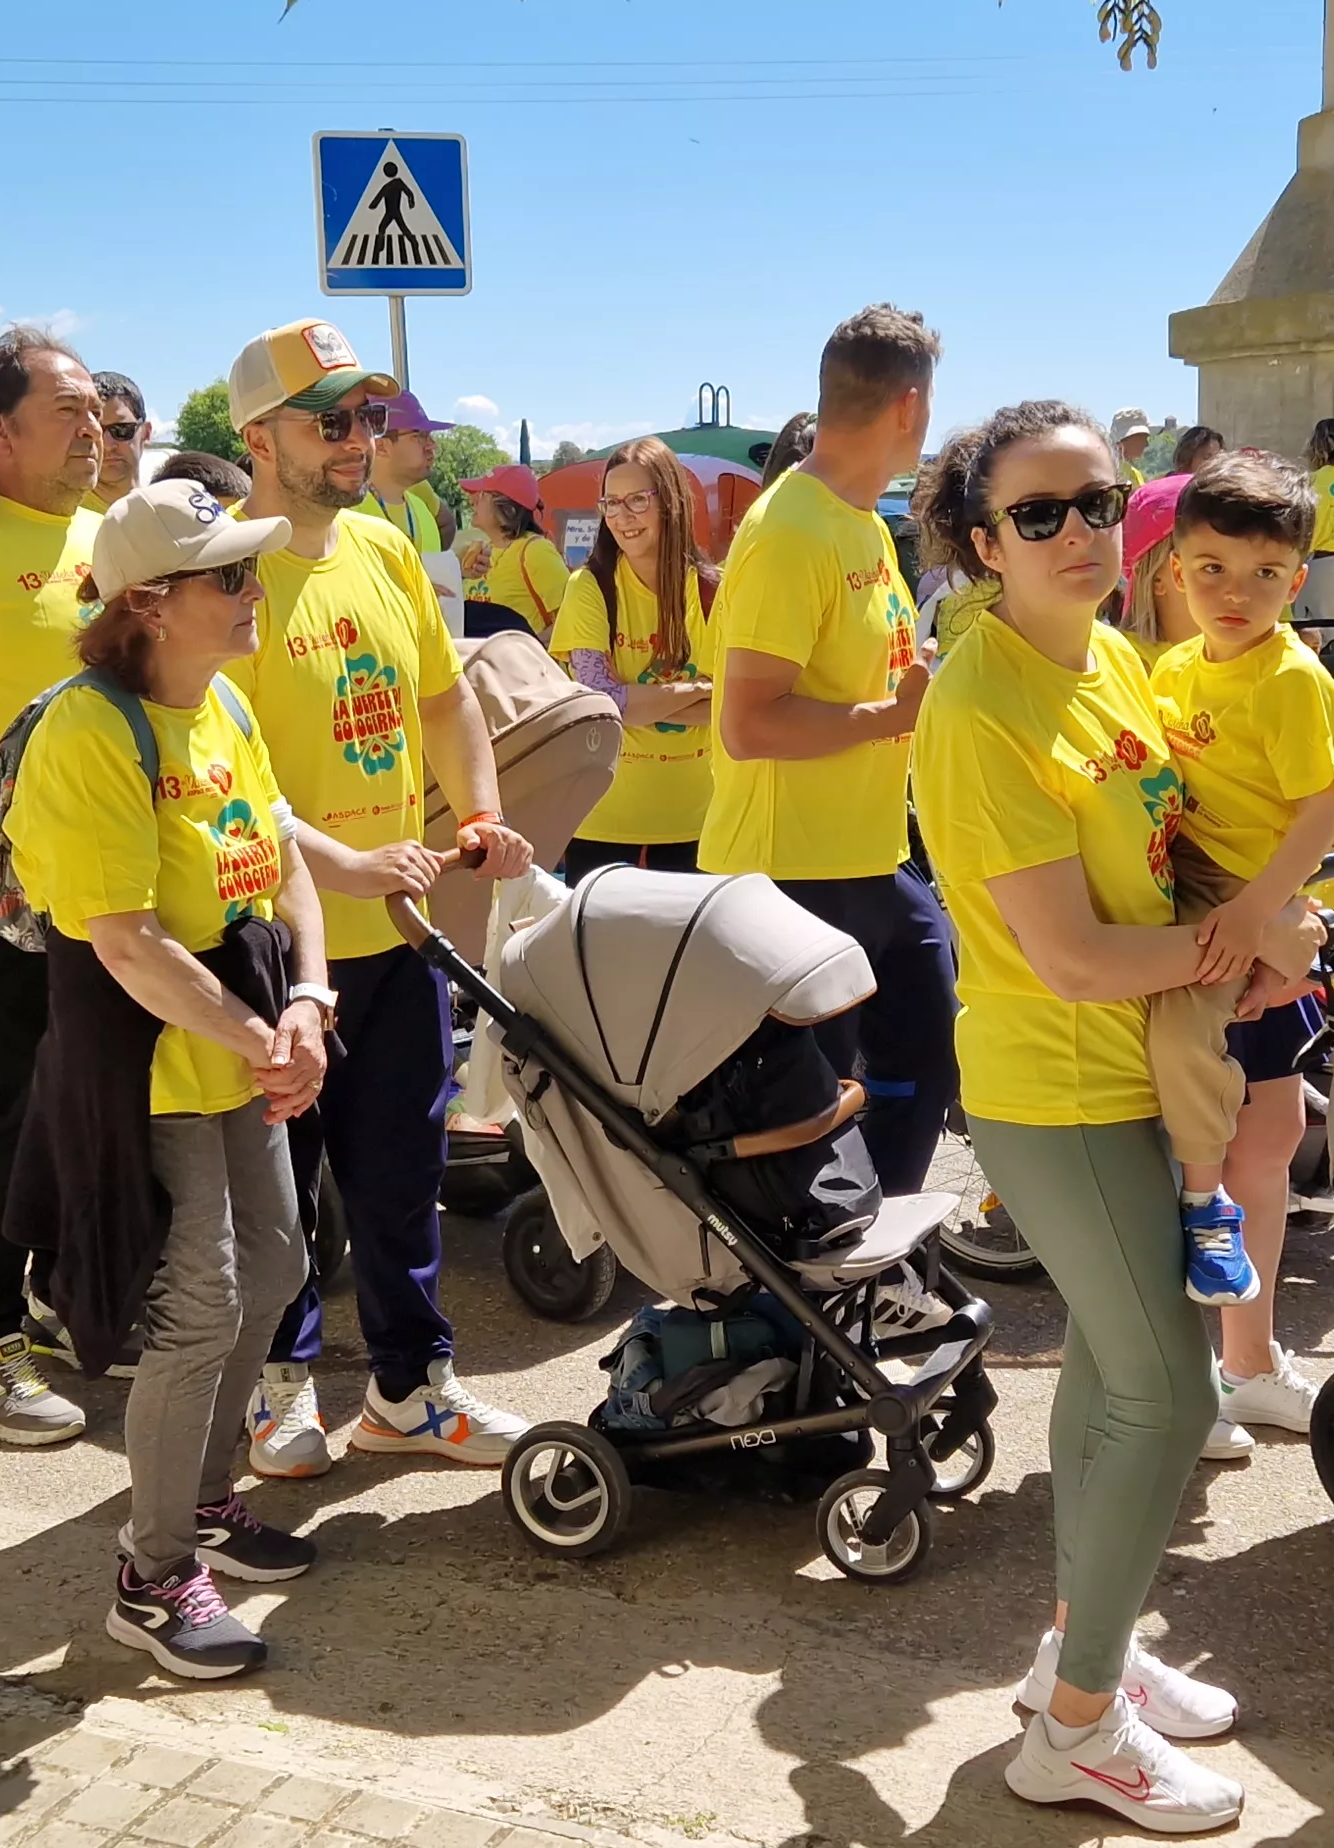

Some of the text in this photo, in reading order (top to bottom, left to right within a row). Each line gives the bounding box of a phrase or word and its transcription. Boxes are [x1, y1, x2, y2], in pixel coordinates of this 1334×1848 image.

[17, 571, 42, 591] 13
[846, 571, 862, 592] 13
[286, 636, 308, 659] 13
[155, 775, 182, 800] 13
[707, 1213, 738, 1246] mutsy
